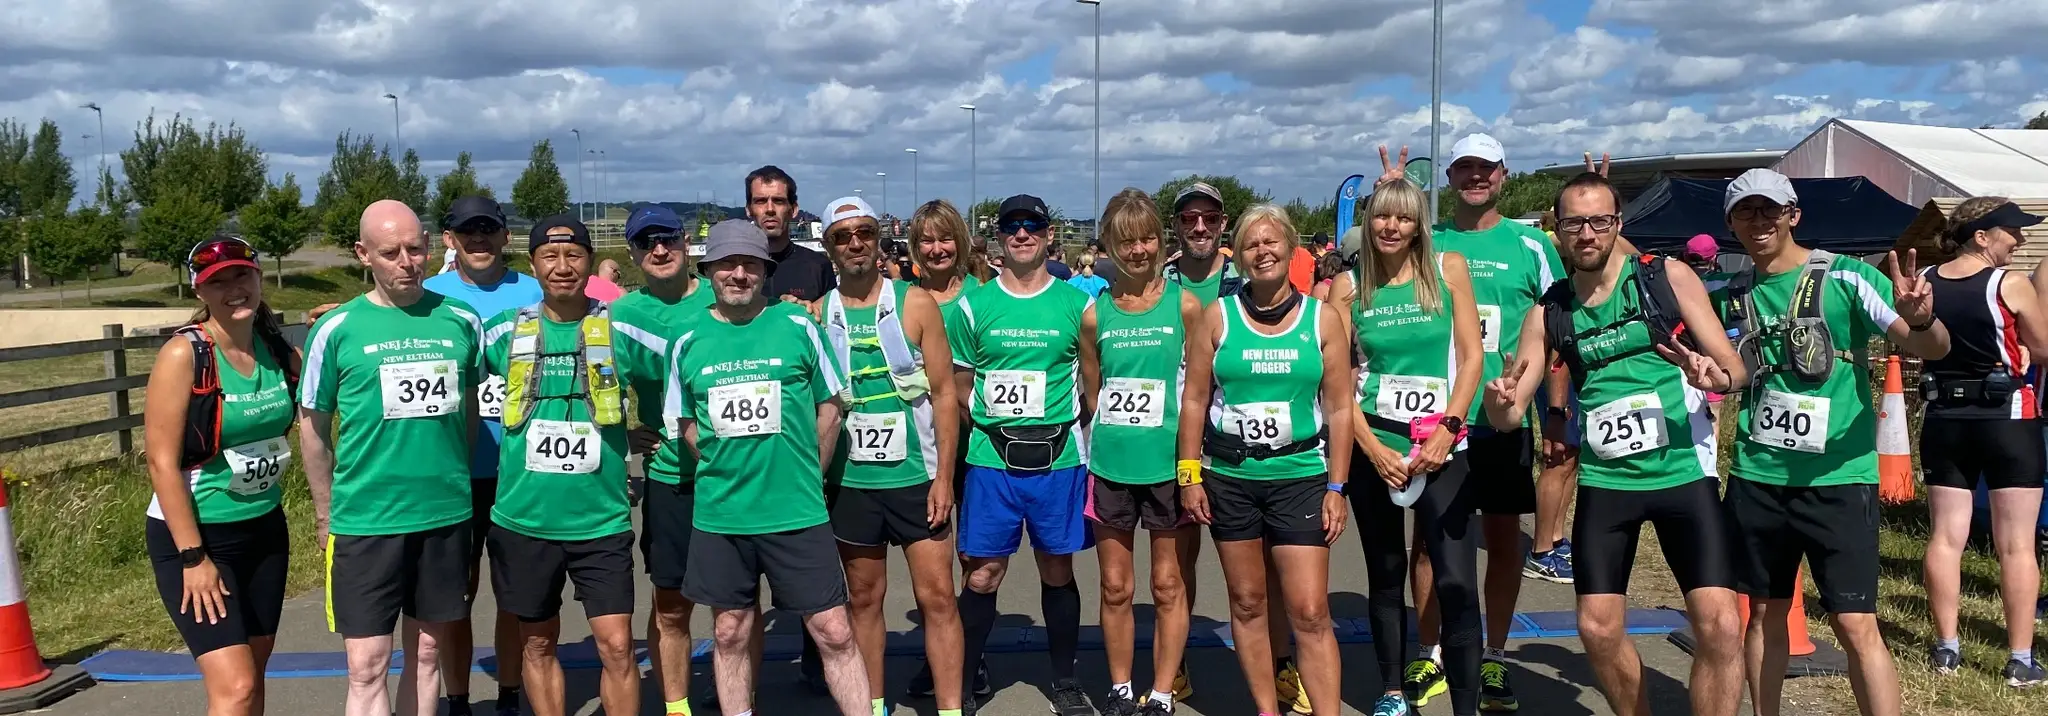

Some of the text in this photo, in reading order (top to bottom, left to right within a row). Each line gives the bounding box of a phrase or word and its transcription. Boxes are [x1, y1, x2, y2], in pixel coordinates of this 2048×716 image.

[1375, 305, 1393, 316] NEJ
[1377, 315, 1432, 328] NEW ELTHAM
[1111, 329, 1128, 338] NEJ
[379, 340, 401, 350] NEJ
[1130, 339, 1162, 347] ELTHAM
[382, 352, 444, 363] NEW ELTHAM
[1242, 349, 1299, 361] NEW ELTHAM
[714, 361, 733, 373] NEJ
[1250, 362, 1292, 374] JOGGERS
[715, 373, 770, 386] NEW ELTHAM
[398, 376, 448, 404] 394
[993, 384, 1028, 405] 261
[721, 397, 769, 422] 486
[1108, 391, 1151, 413] 262
[1394, 391, 1436, 414] 102
[243, 407, 261, 417] NEW
[1236, 416, 1279, 441] 138
[1598, 411, 1646, 445] 251
[1760, 406, 1811, 437] 340
[855, 428, 894, 449] 127
[536, 436, 587, 460] 404
[242, 455, 280, 483] 506
